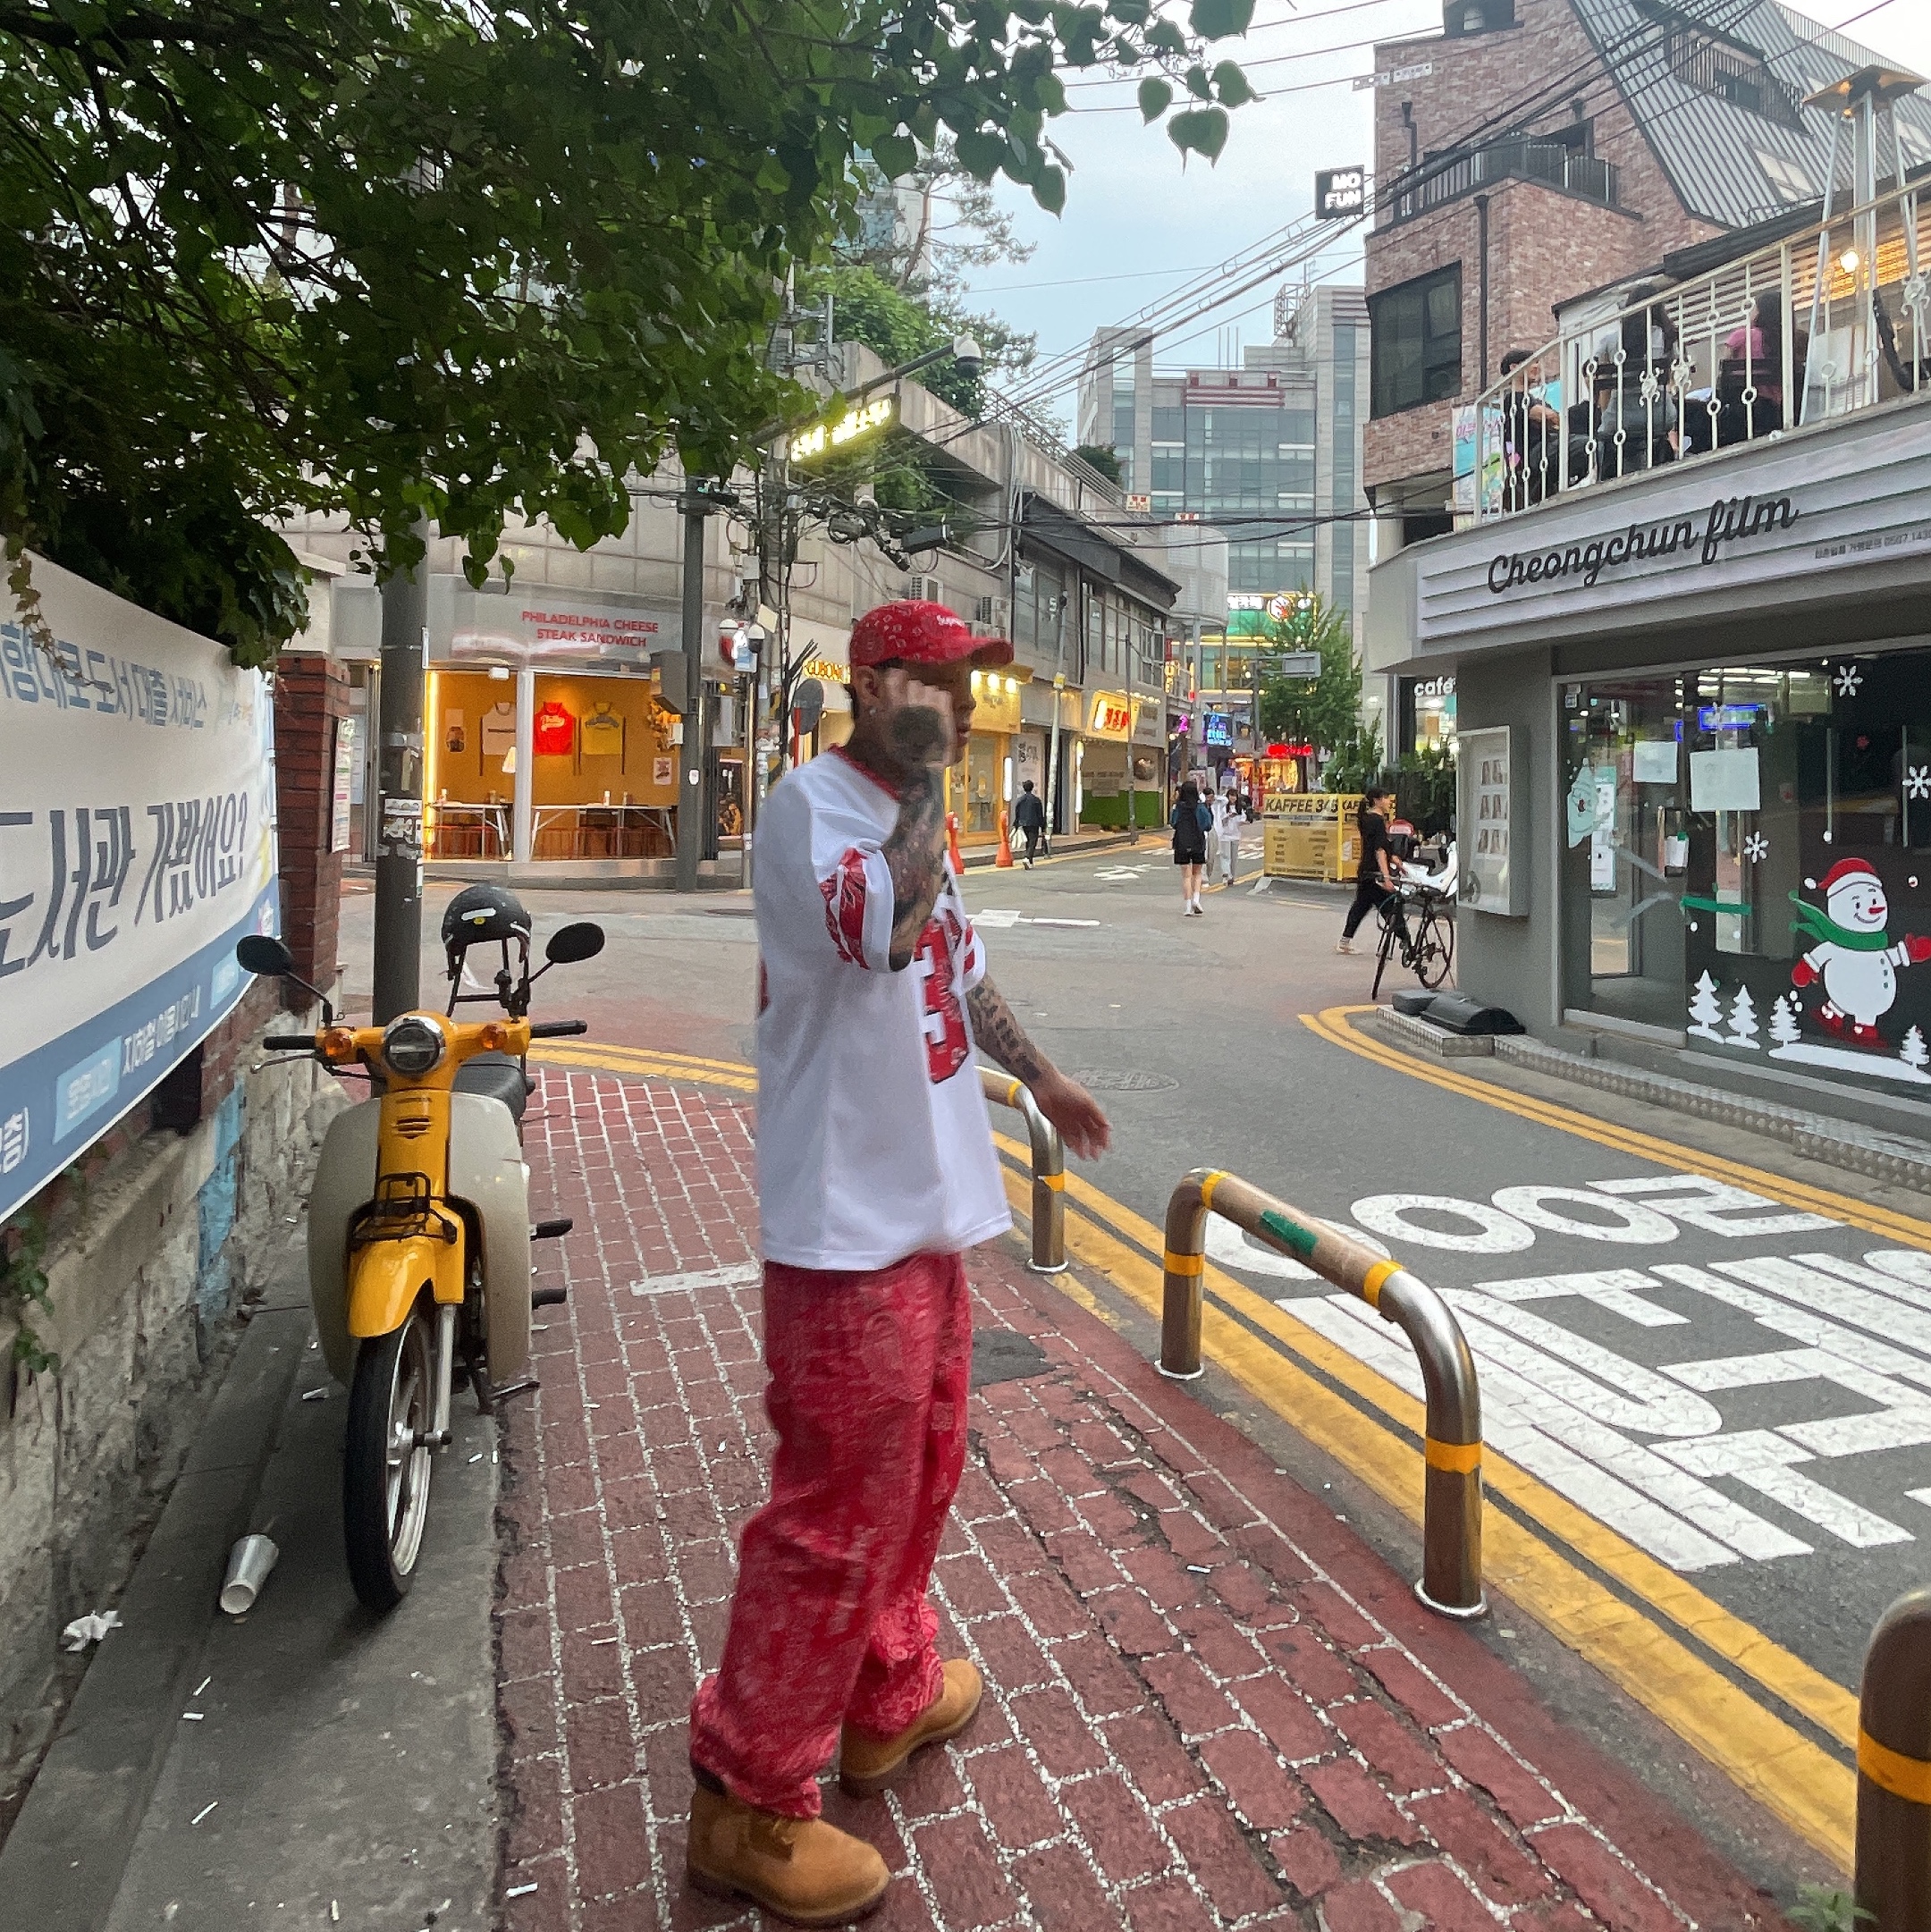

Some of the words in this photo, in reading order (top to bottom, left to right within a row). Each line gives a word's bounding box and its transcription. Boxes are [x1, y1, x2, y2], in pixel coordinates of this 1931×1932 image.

[1488, 519, 1699, 594] Cheongchun
[1702, 495, 1800, 565] film
[522, 611, 611, 629] PHILADELPHIA
[614, 619, 659, 634] CHEESE
[536, 629, 577, 641] STEAK
[580, 631, 647, 647] SANDWICH
[1265, 798, 1313, 813] KAFFEE
[134, 790, 248, 927] 가봤어요?
